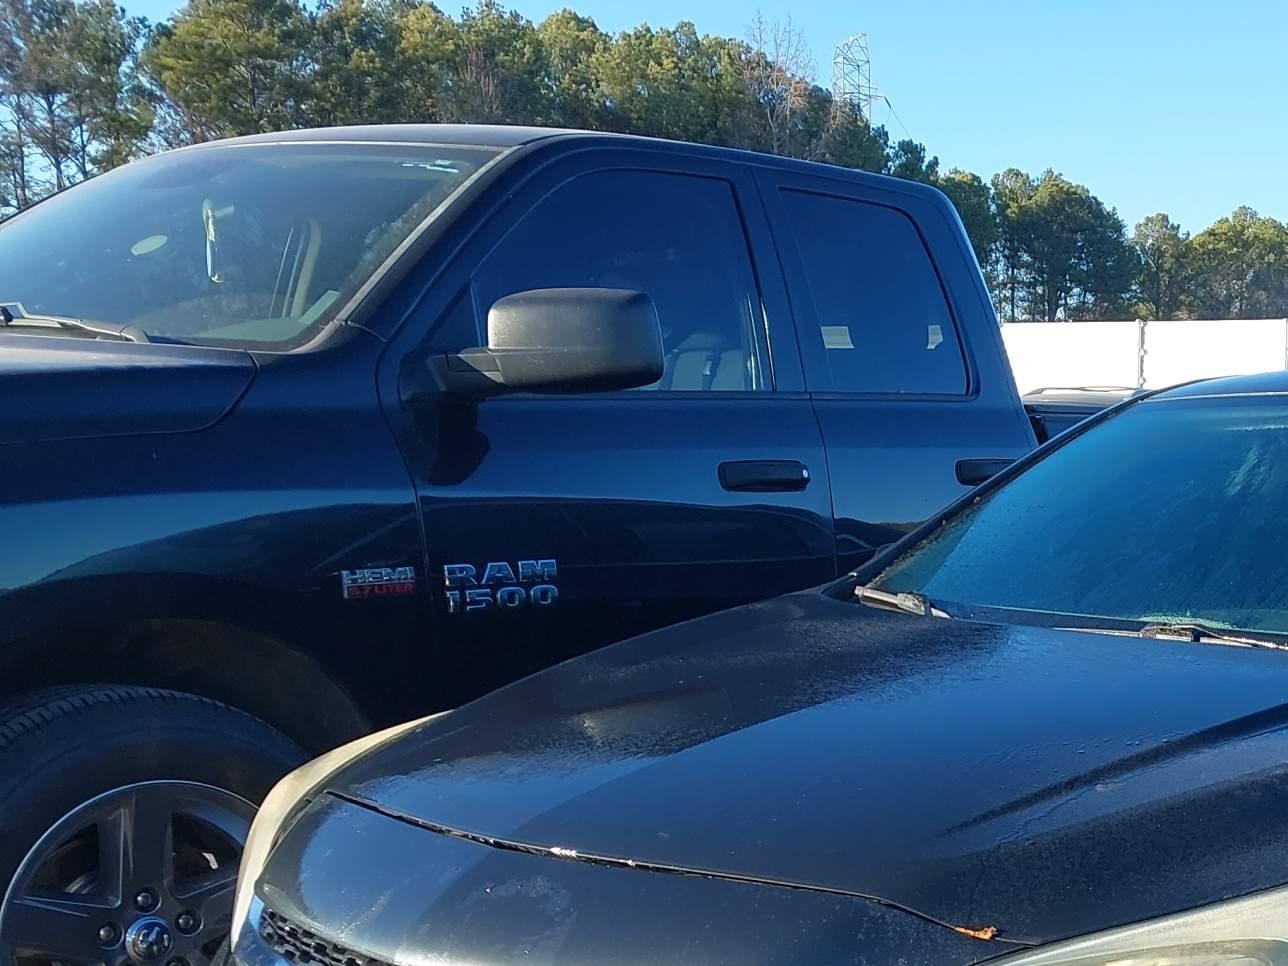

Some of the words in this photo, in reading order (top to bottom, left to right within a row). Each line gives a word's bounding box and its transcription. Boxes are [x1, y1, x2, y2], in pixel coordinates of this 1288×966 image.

[341, 567, 415, 584] HEMI
[443, 559, 558, 586] RAM
[446, 585, 559, 613] 1500
